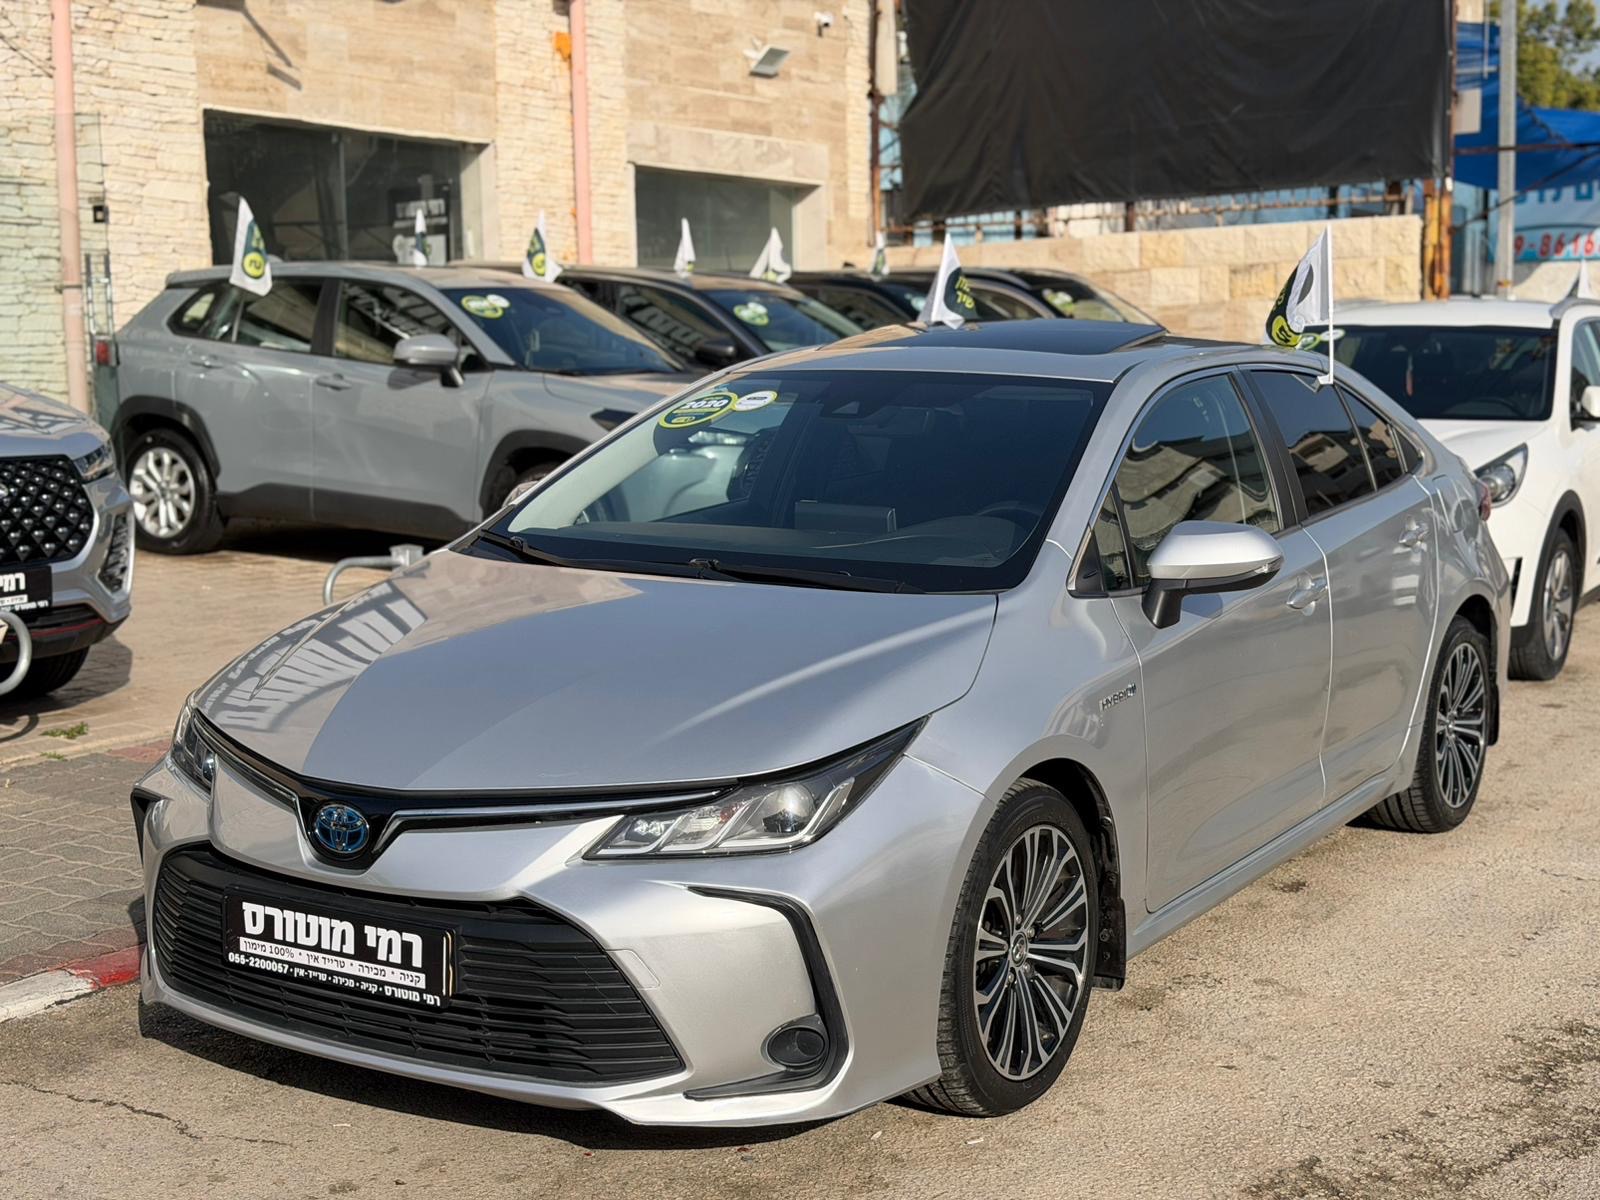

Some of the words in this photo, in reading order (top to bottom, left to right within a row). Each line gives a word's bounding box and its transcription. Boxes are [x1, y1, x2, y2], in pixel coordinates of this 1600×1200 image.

[681, 399, 730, 409] 2020
[1101, 683, 1136, 710] HYBRID
[242, 901, 355, 956] מוטורס
[243, 940, 267, 953] מימון
[269, 945, 295, 959] 100%
[364, 925, 423, 968] רמי
[228, 952, 289, 975] 055-2200057
[306, 952, 320, 965] אין
[321, 956, 346, 969] טרייד
[358, 963, 387, 978] מכירה
[332, 975, 355, 988] מכירה
[399, 971, 421, 985] קניה
[360, 981, 378, 994] קניה
[383, 985, 421, 1002] מוטורס
[422, 993, 441, 1007] רמי
